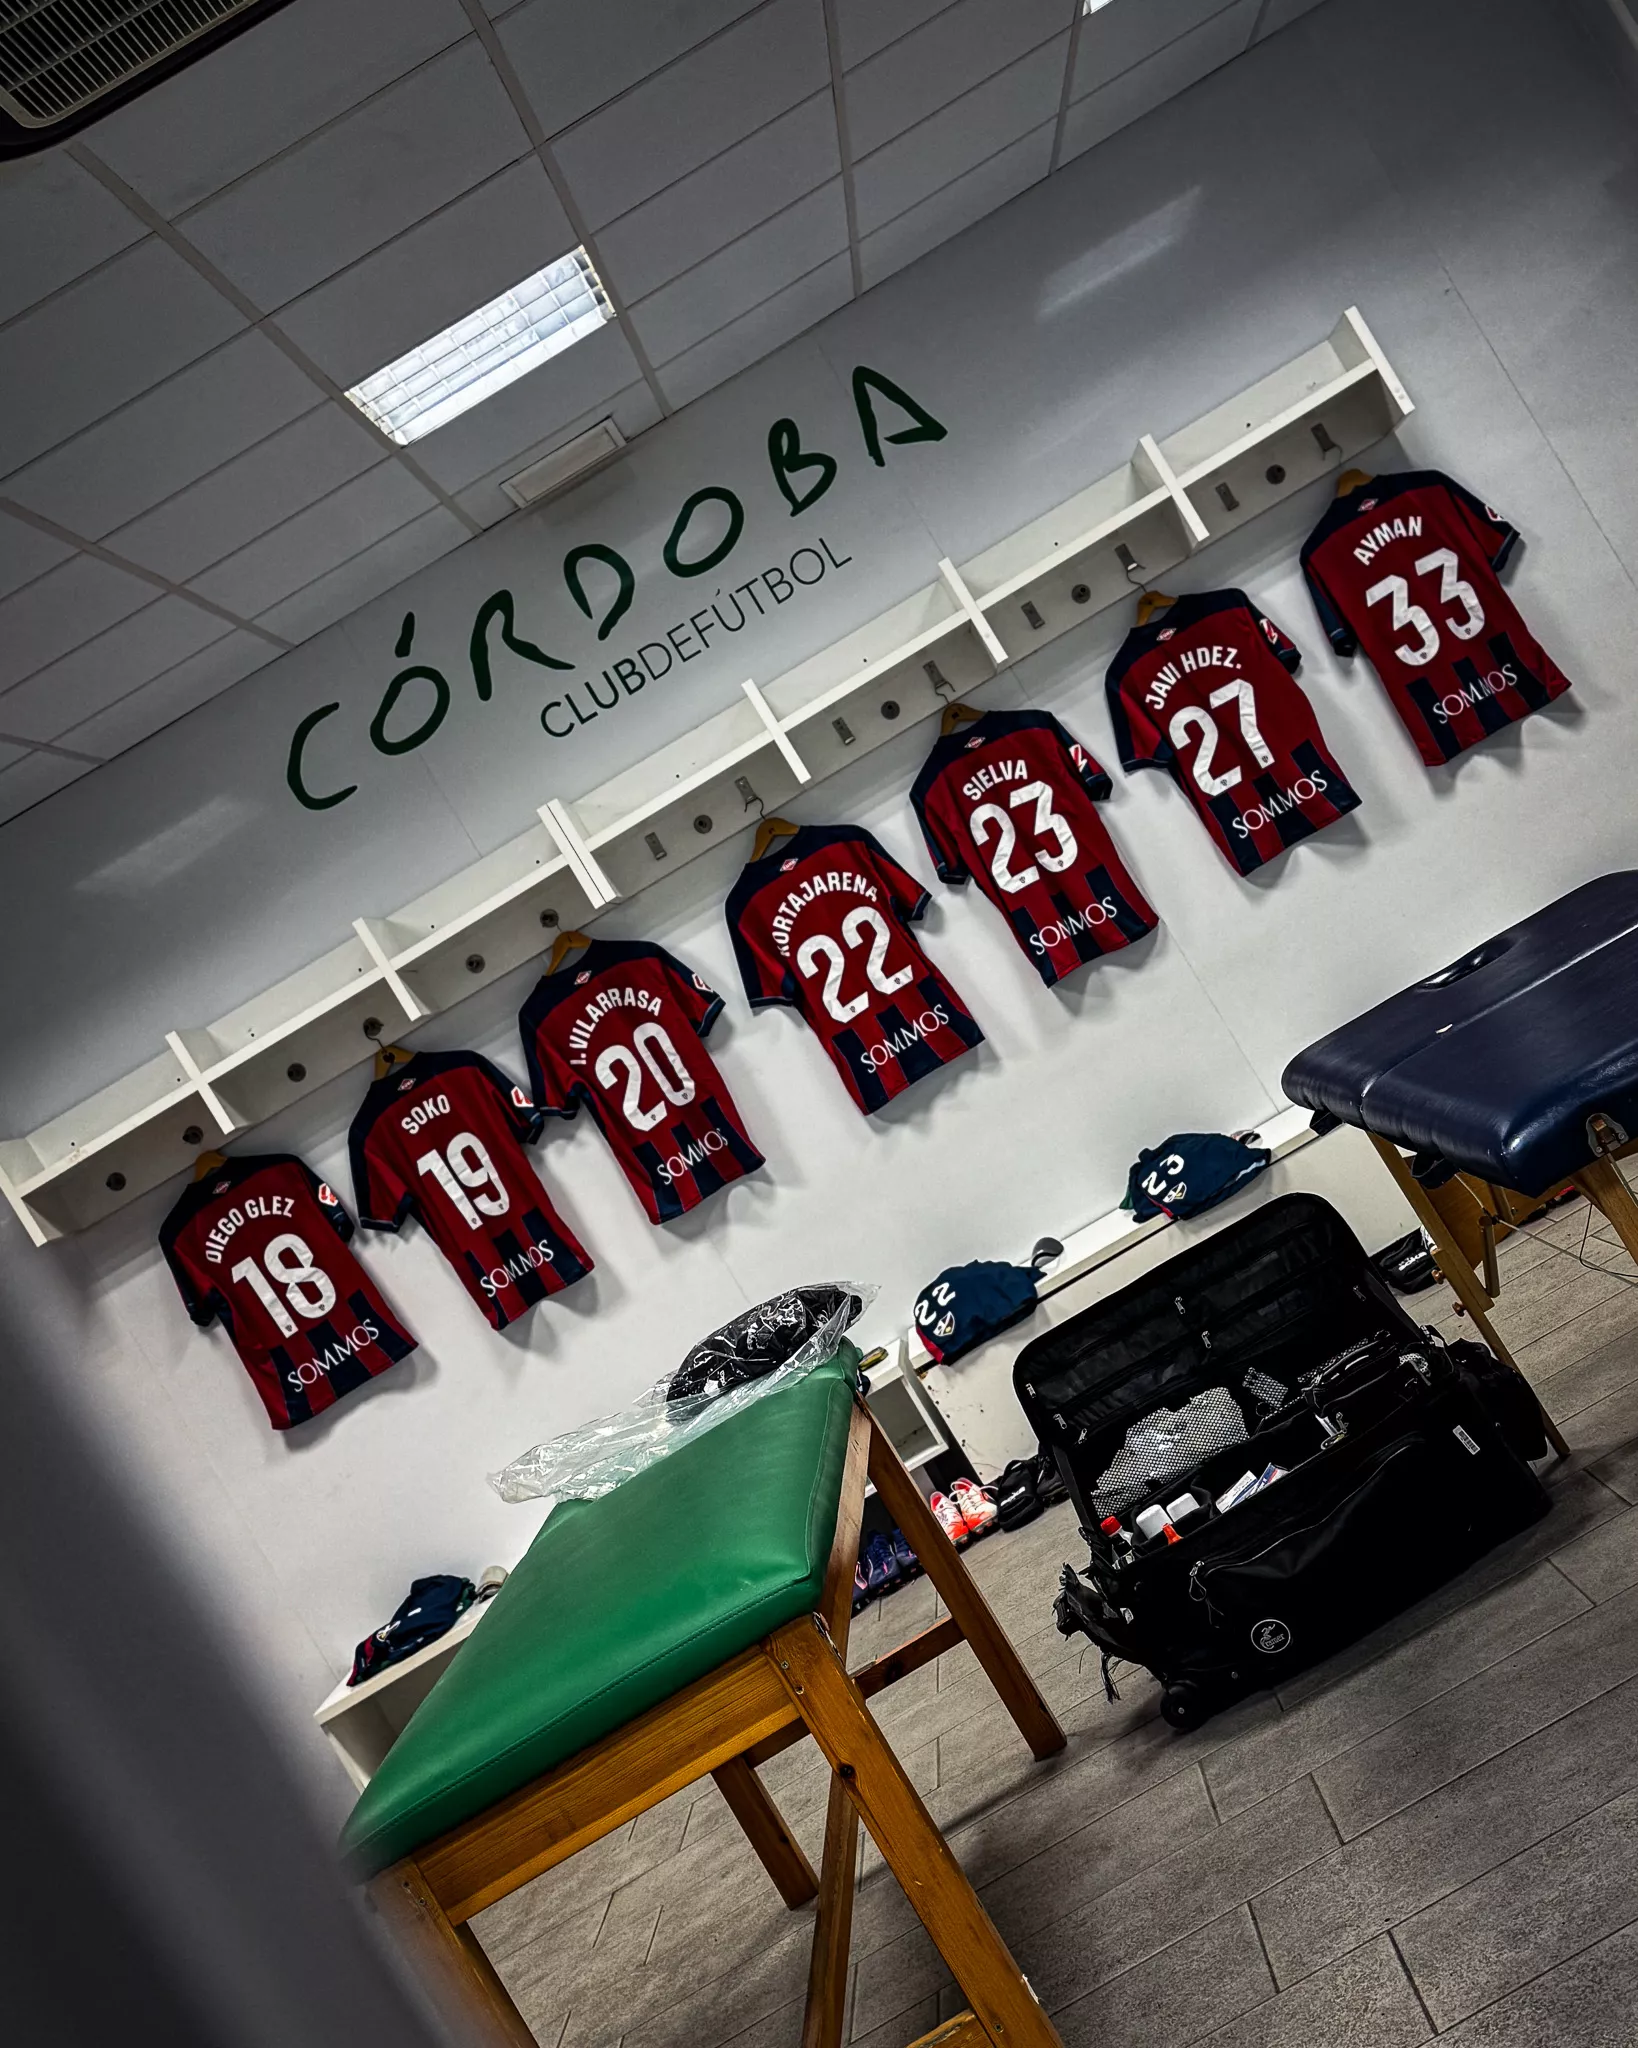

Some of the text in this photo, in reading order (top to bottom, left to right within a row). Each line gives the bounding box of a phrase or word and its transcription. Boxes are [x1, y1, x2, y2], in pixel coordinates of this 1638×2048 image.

[1353, 516, 1422, 566] AYMAN
[286, 365, 948, 811] CÓRDOBA
[1365, 547, 1485, 666] 33
[540, 537, 852, 738] CLUBDEFÚTBOL
[1145, 645, 1242, 710] JAVI HDEZ.
[1432, 663, 1518, 725] SOMMOS
[1168, 678, 1276, 797] 27
[962, 759, 1028, 801] SIELVA
[1232, 769, 1328, 839] SOMMOS
[969, 780, 1078, 894] 23
[1029, 895, 1118, 956] SOMMOS
[796, 905, 914, 1024] 22
[860, 1003, 949, 1074] SOMMOS
[594, 1022, 696, 1132] 20
[401, 1094, 451, 1135] SOKO
[416, 1132, 510, 1231] 19
[1141, 1153, 1185, 1196] 23
[205, 1195, 295, 1264] DIEGO GLEZ
[231, 1233, 337, 1339] 18
[479, 1239, 554, 1298] SOMMOS
[914, 1281, 956, 1326] 22
[287, 1318, 379, 1393] SOMMOS
